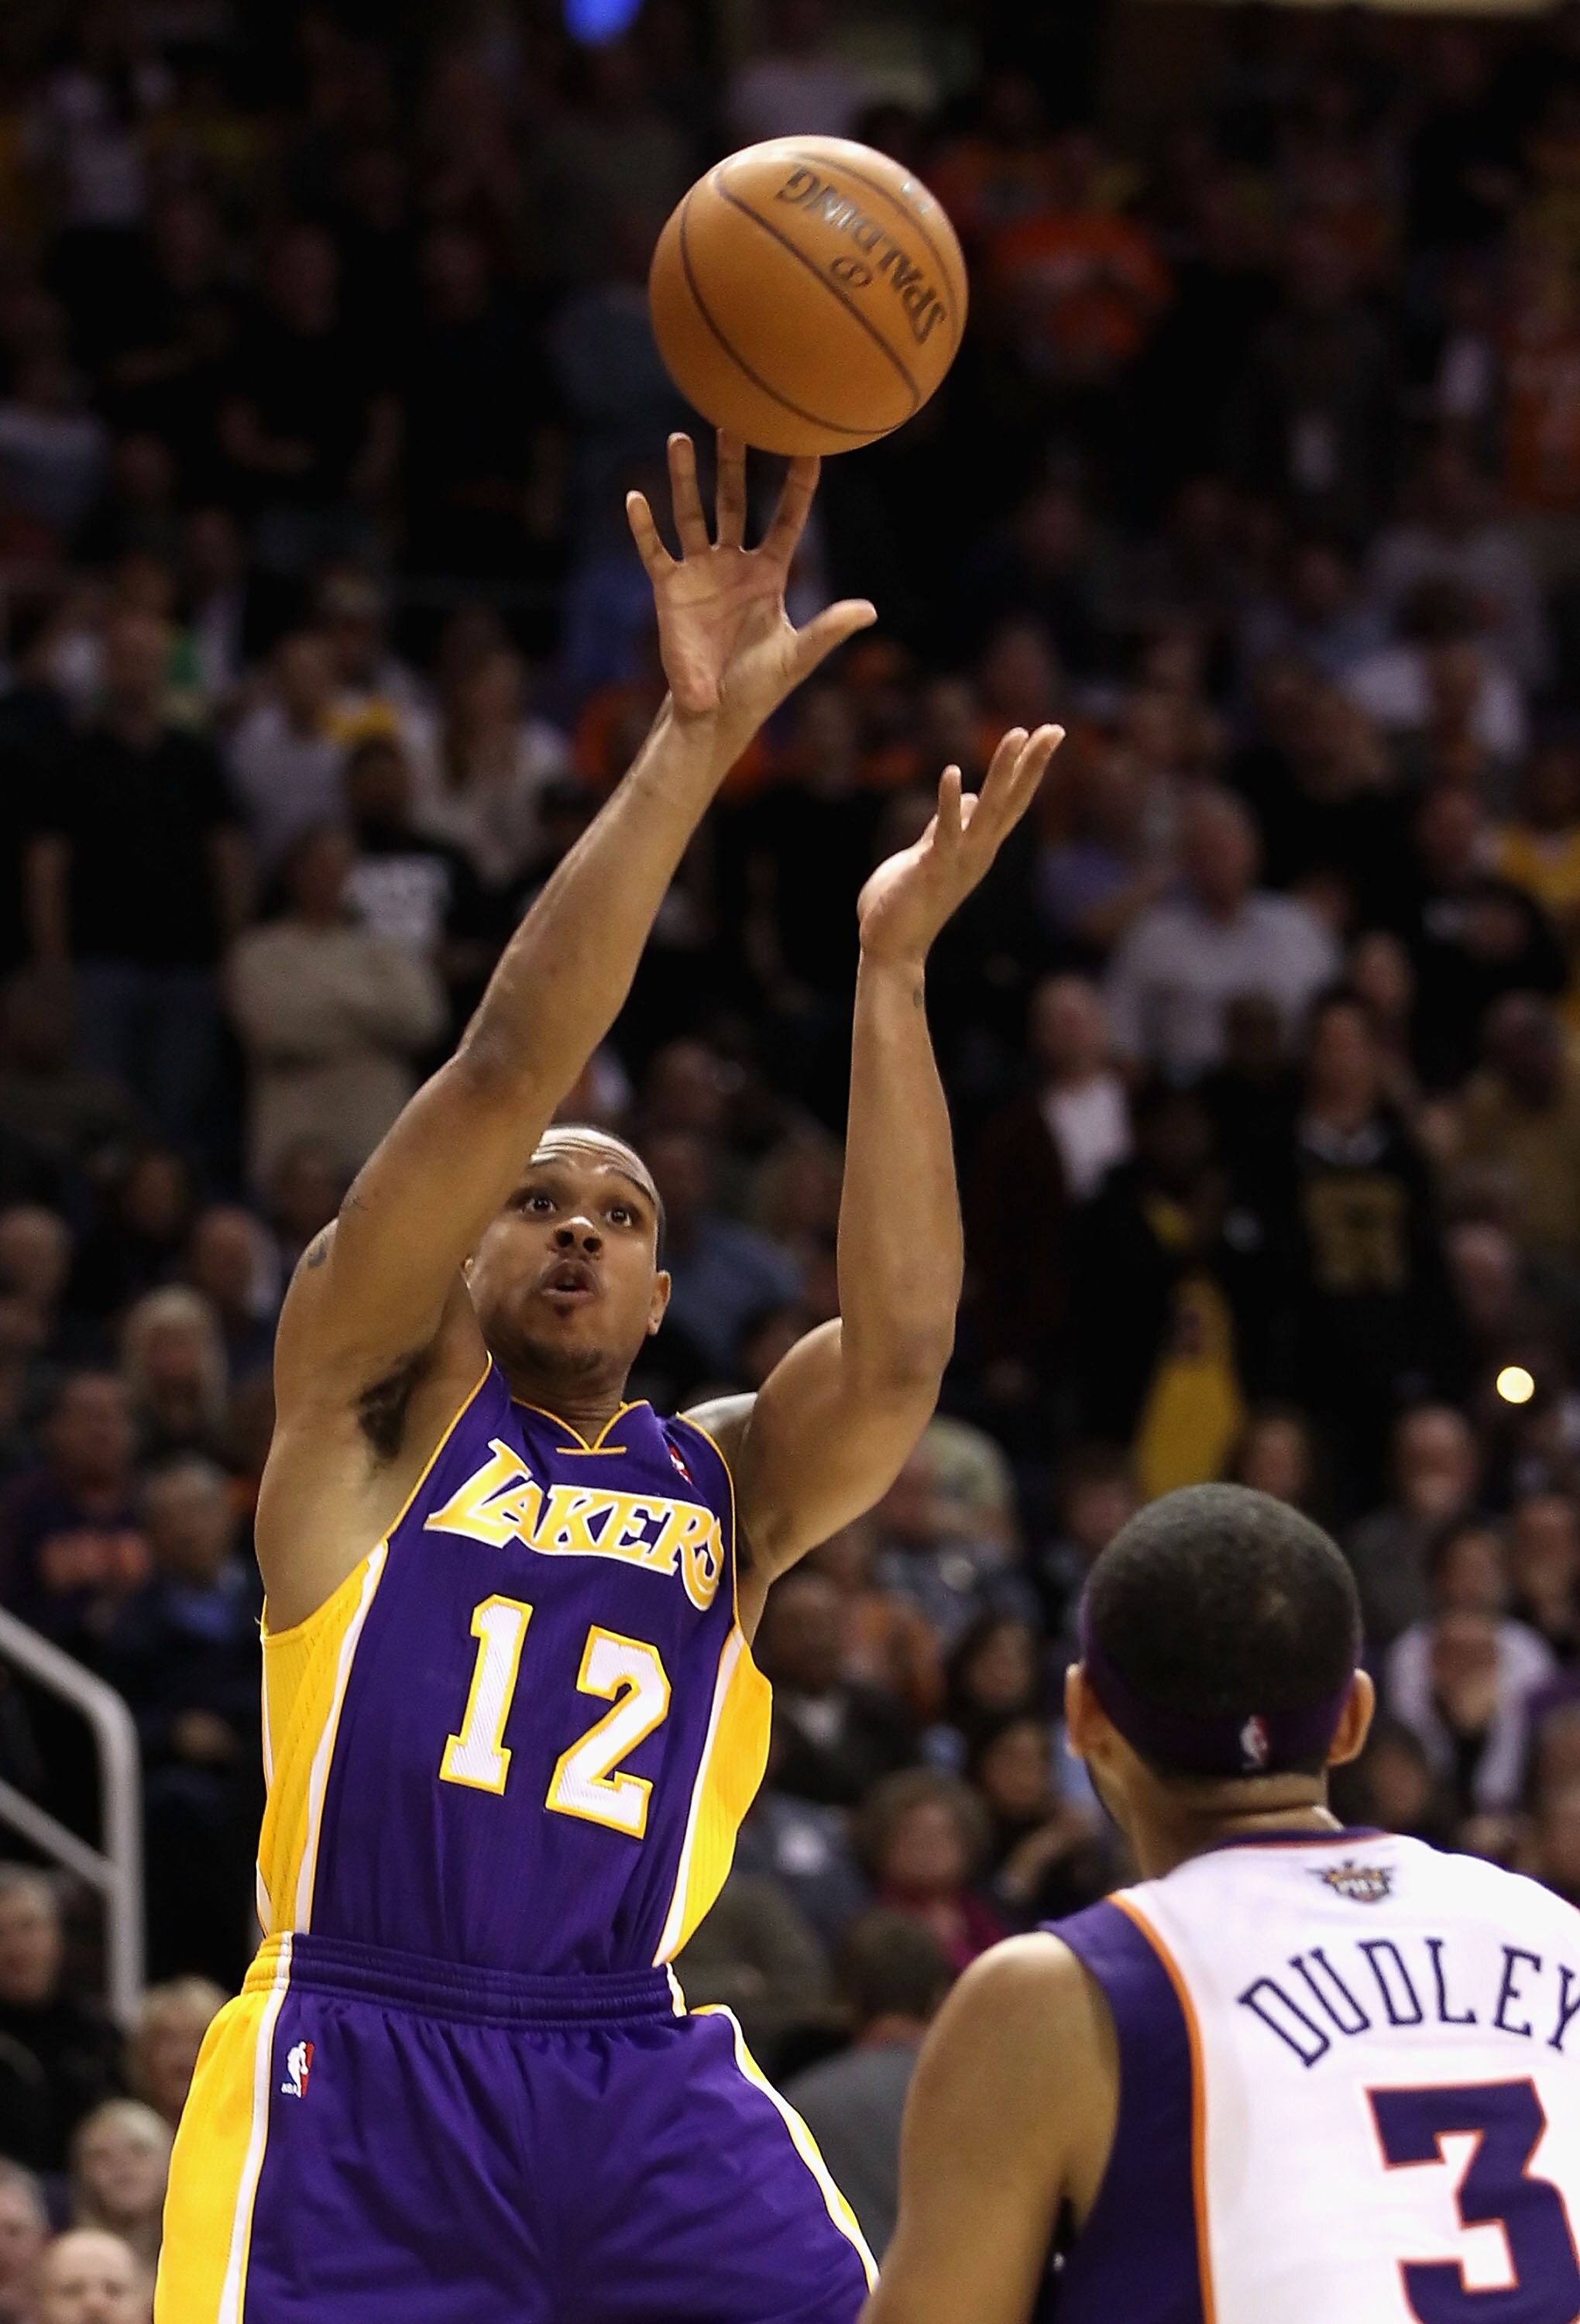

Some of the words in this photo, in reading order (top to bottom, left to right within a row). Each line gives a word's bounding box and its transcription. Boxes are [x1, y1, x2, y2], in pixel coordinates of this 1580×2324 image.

[775, 167, 946, 346] SPALDING
[424, 1439, 724, 1611] LAKERS
[439, 1593, 672, 1839] 12
[1237, 1937, 1580, 2068] DUDLEY
[1365, 2077, 1580, 2324] 3
